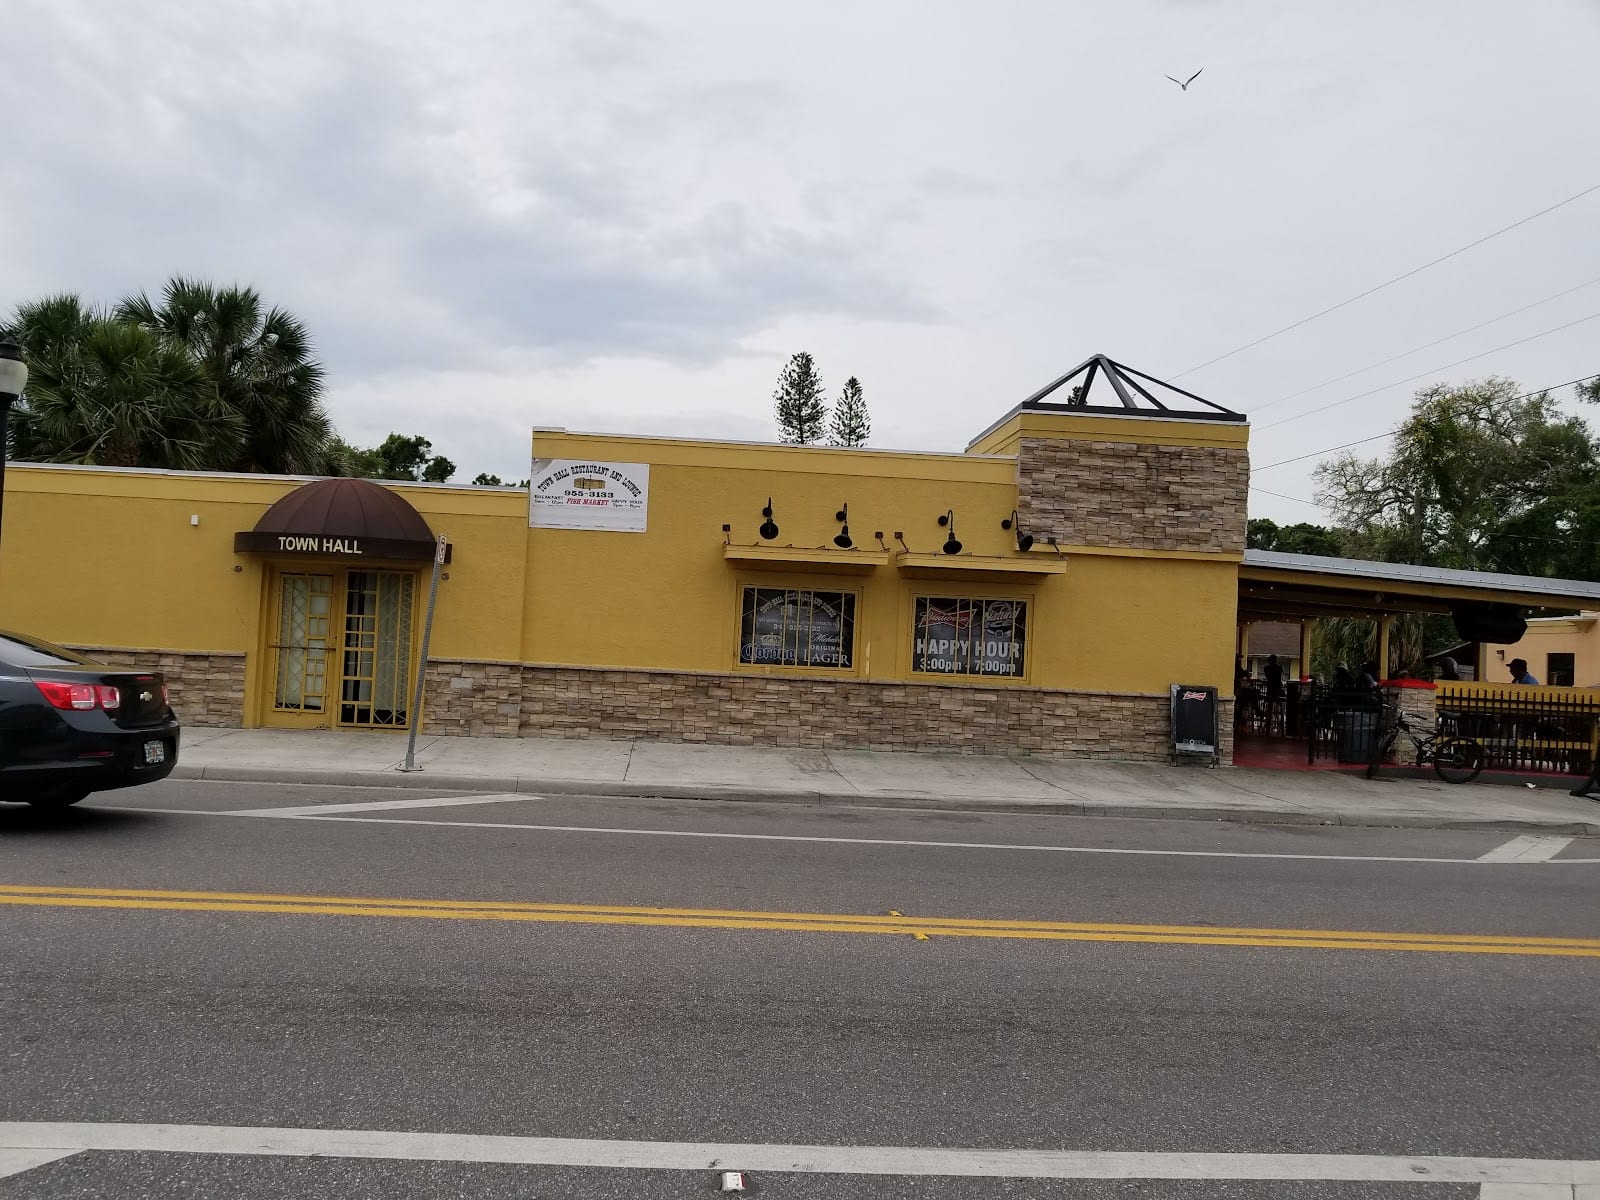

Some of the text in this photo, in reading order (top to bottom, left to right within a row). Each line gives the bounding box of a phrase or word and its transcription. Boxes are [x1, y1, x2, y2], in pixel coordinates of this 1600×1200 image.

[537, 464, 642, 497] TOWN HALL RESTAURANT AND LOUNGE
[564, 490, 614, 498] 955-3133
[278, 536, 363, 554] TOWN HALL
[741, 642, 797, 661] Corona
[810, 644, 844, 652] ORIGINAL
[916, 638, 1020, 658] HAPPY HOUR
[803, 649, 850, 665] LAGER
[920, 657, 962, 672] 3:00pm
[974, 660, 1016, 674] 7:00pm
